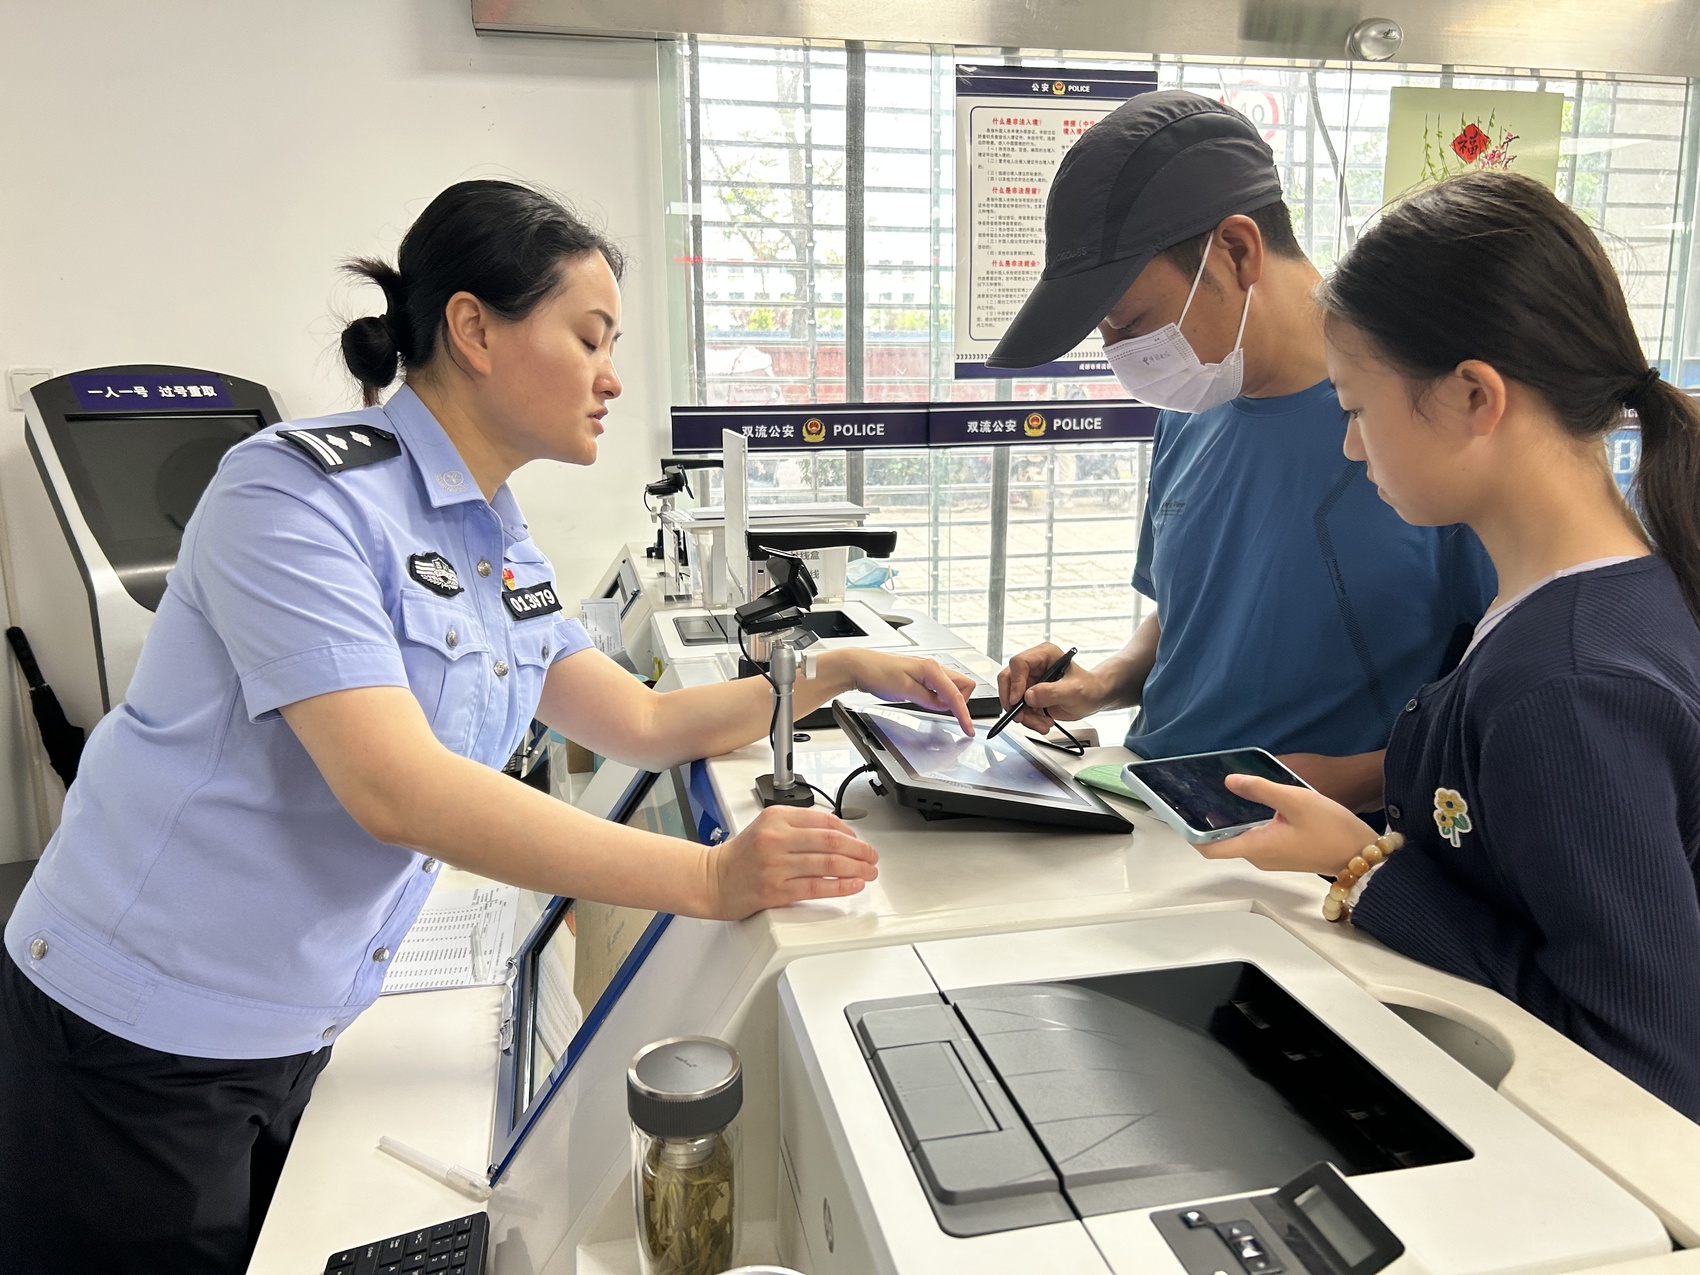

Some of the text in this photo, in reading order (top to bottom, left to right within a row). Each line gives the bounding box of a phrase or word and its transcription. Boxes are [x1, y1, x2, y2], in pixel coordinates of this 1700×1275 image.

[1031, 82, 1049, 92] 公安
[1068, 85, 1090, 93] POLICE
[87, 385, 218, 398] 一人一号 过号重取
[833, 423, 885, 437] POLICE
[966, 420, 1017, 433] 双流公安
[1053, 417, 1102, 431] POLICE
[741, 424, 795, 438] 双流公安
[510, 588, 556, 613] 013979
